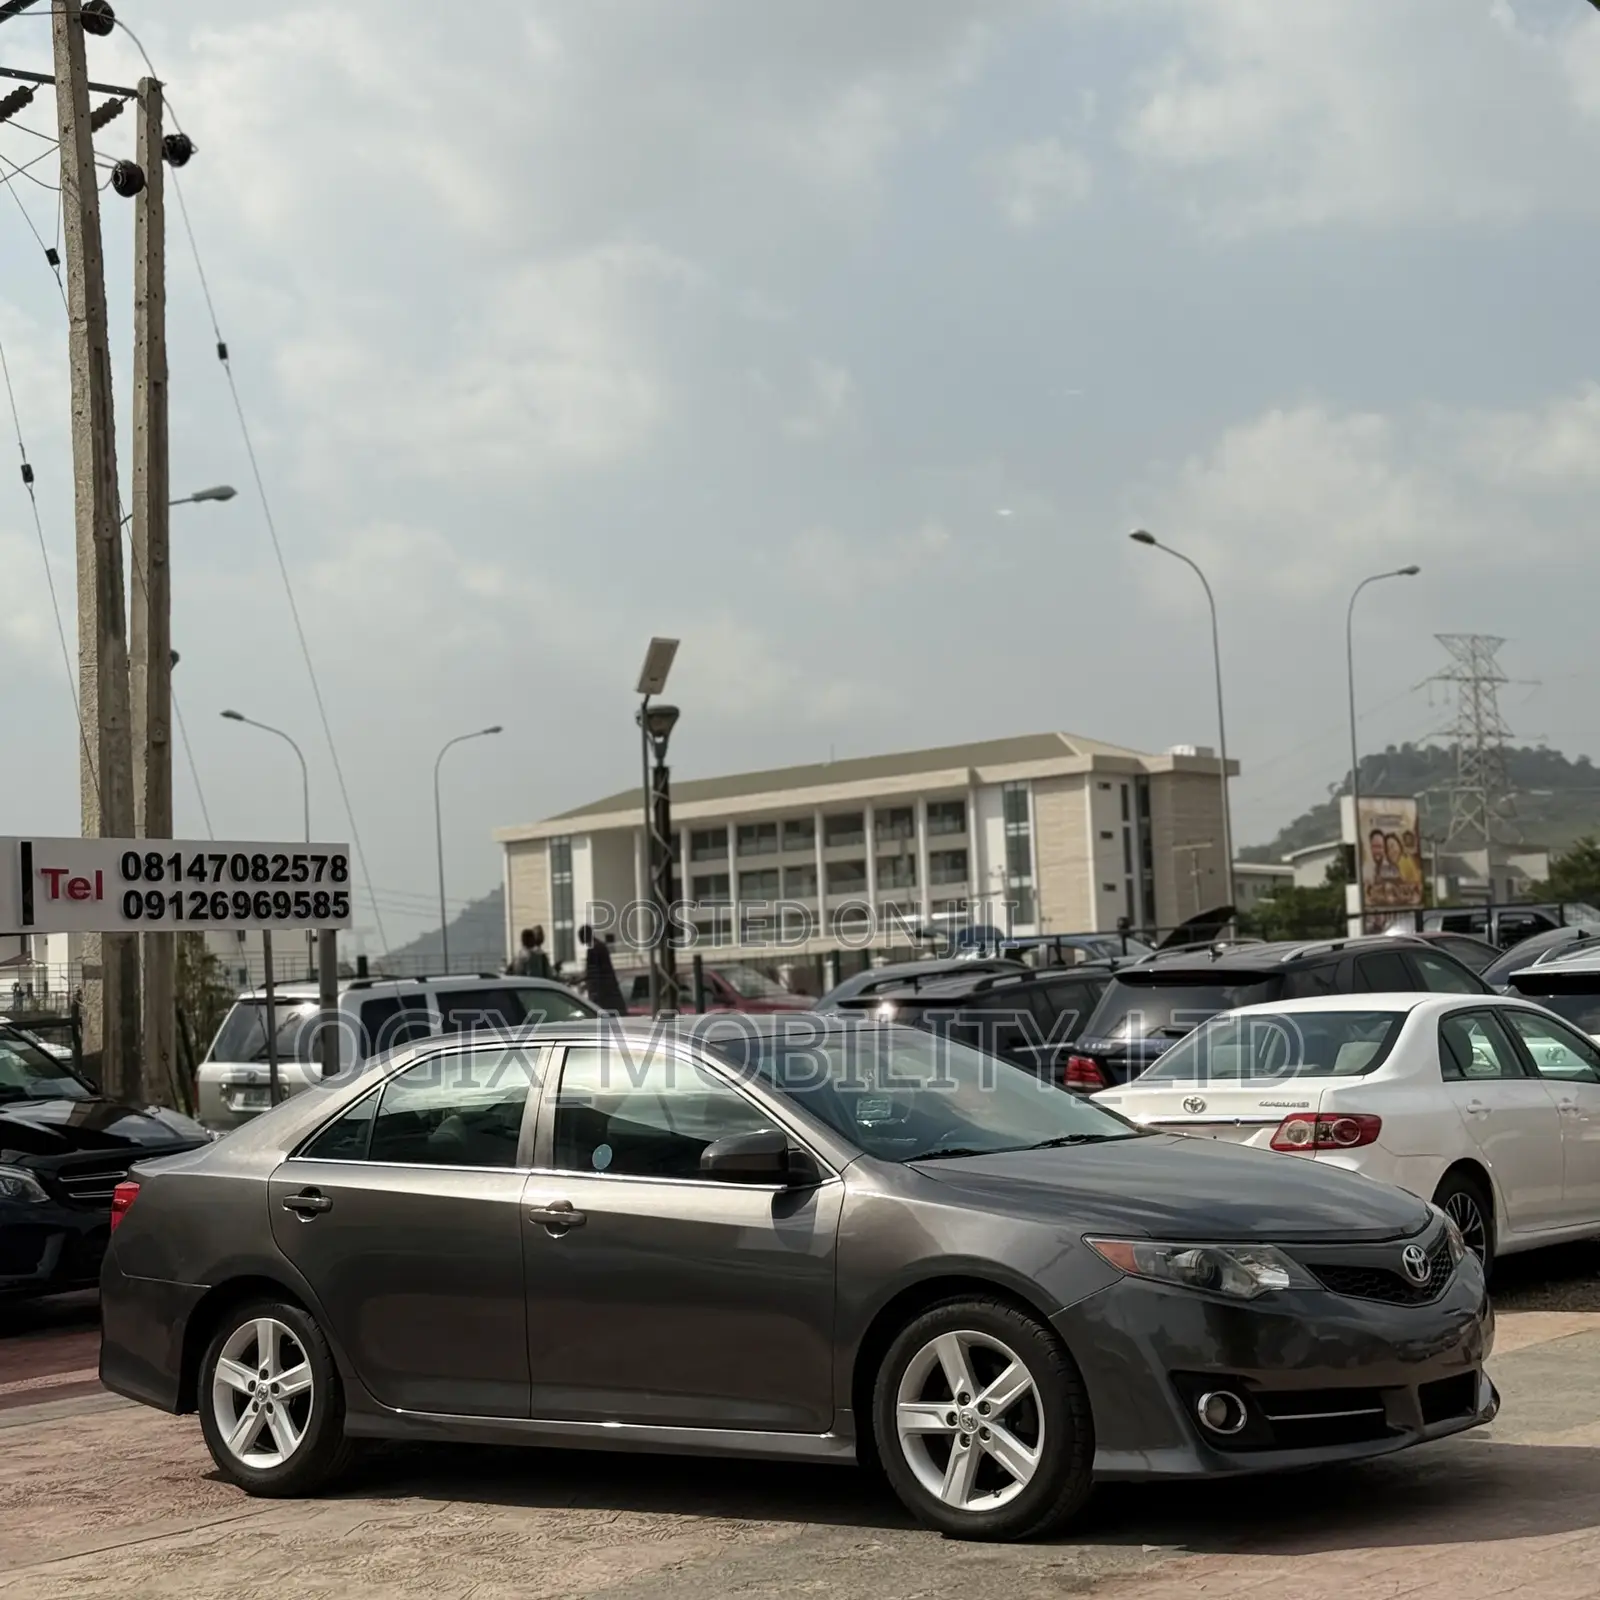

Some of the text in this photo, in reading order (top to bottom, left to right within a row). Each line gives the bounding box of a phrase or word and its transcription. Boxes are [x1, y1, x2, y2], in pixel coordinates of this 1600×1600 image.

[121, 851, 348, 883] 08147082578
[41, 868, 103, 900] Tel
[123, 890, 349, 920] 09126969585
